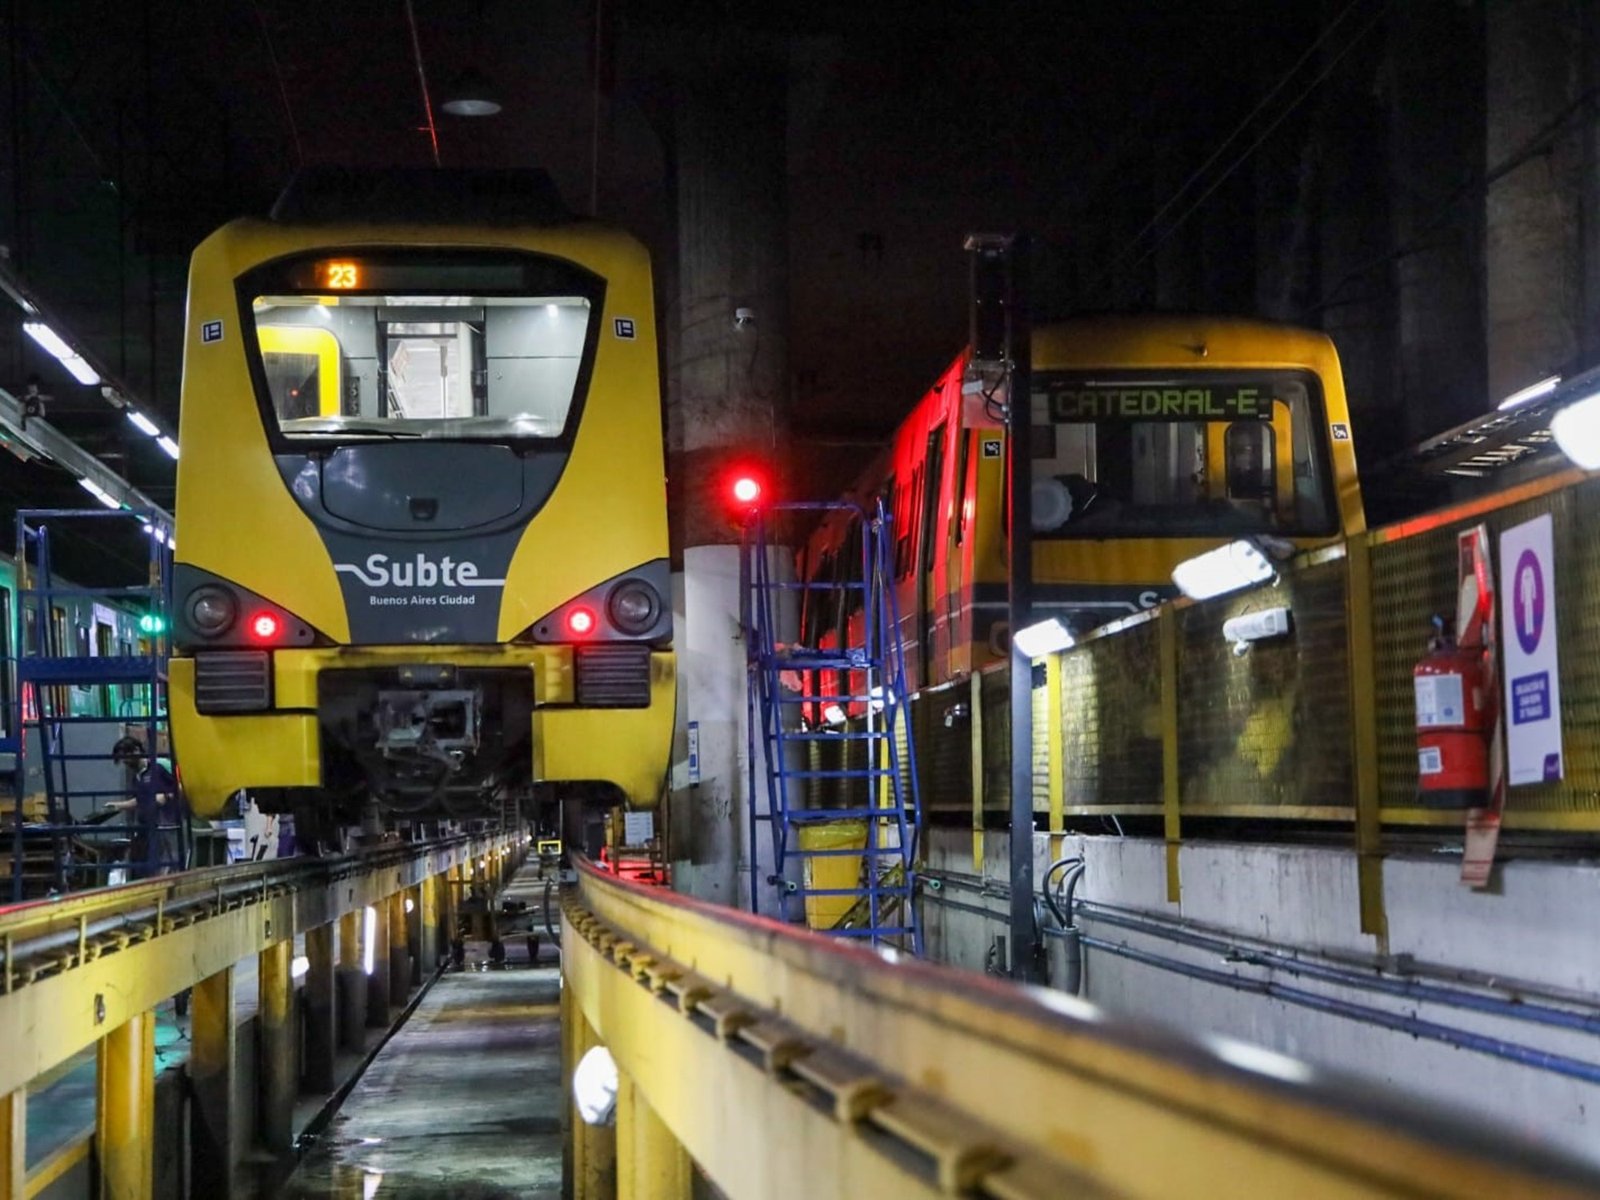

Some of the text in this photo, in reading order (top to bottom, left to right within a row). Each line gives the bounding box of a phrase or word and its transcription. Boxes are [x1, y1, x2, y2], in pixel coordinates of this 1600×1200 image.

[328, 263, 357, 289] 23
[366, 553, 479, 587] Subte
[369, 594, 476, 606] Buenos Aires Ciudad
